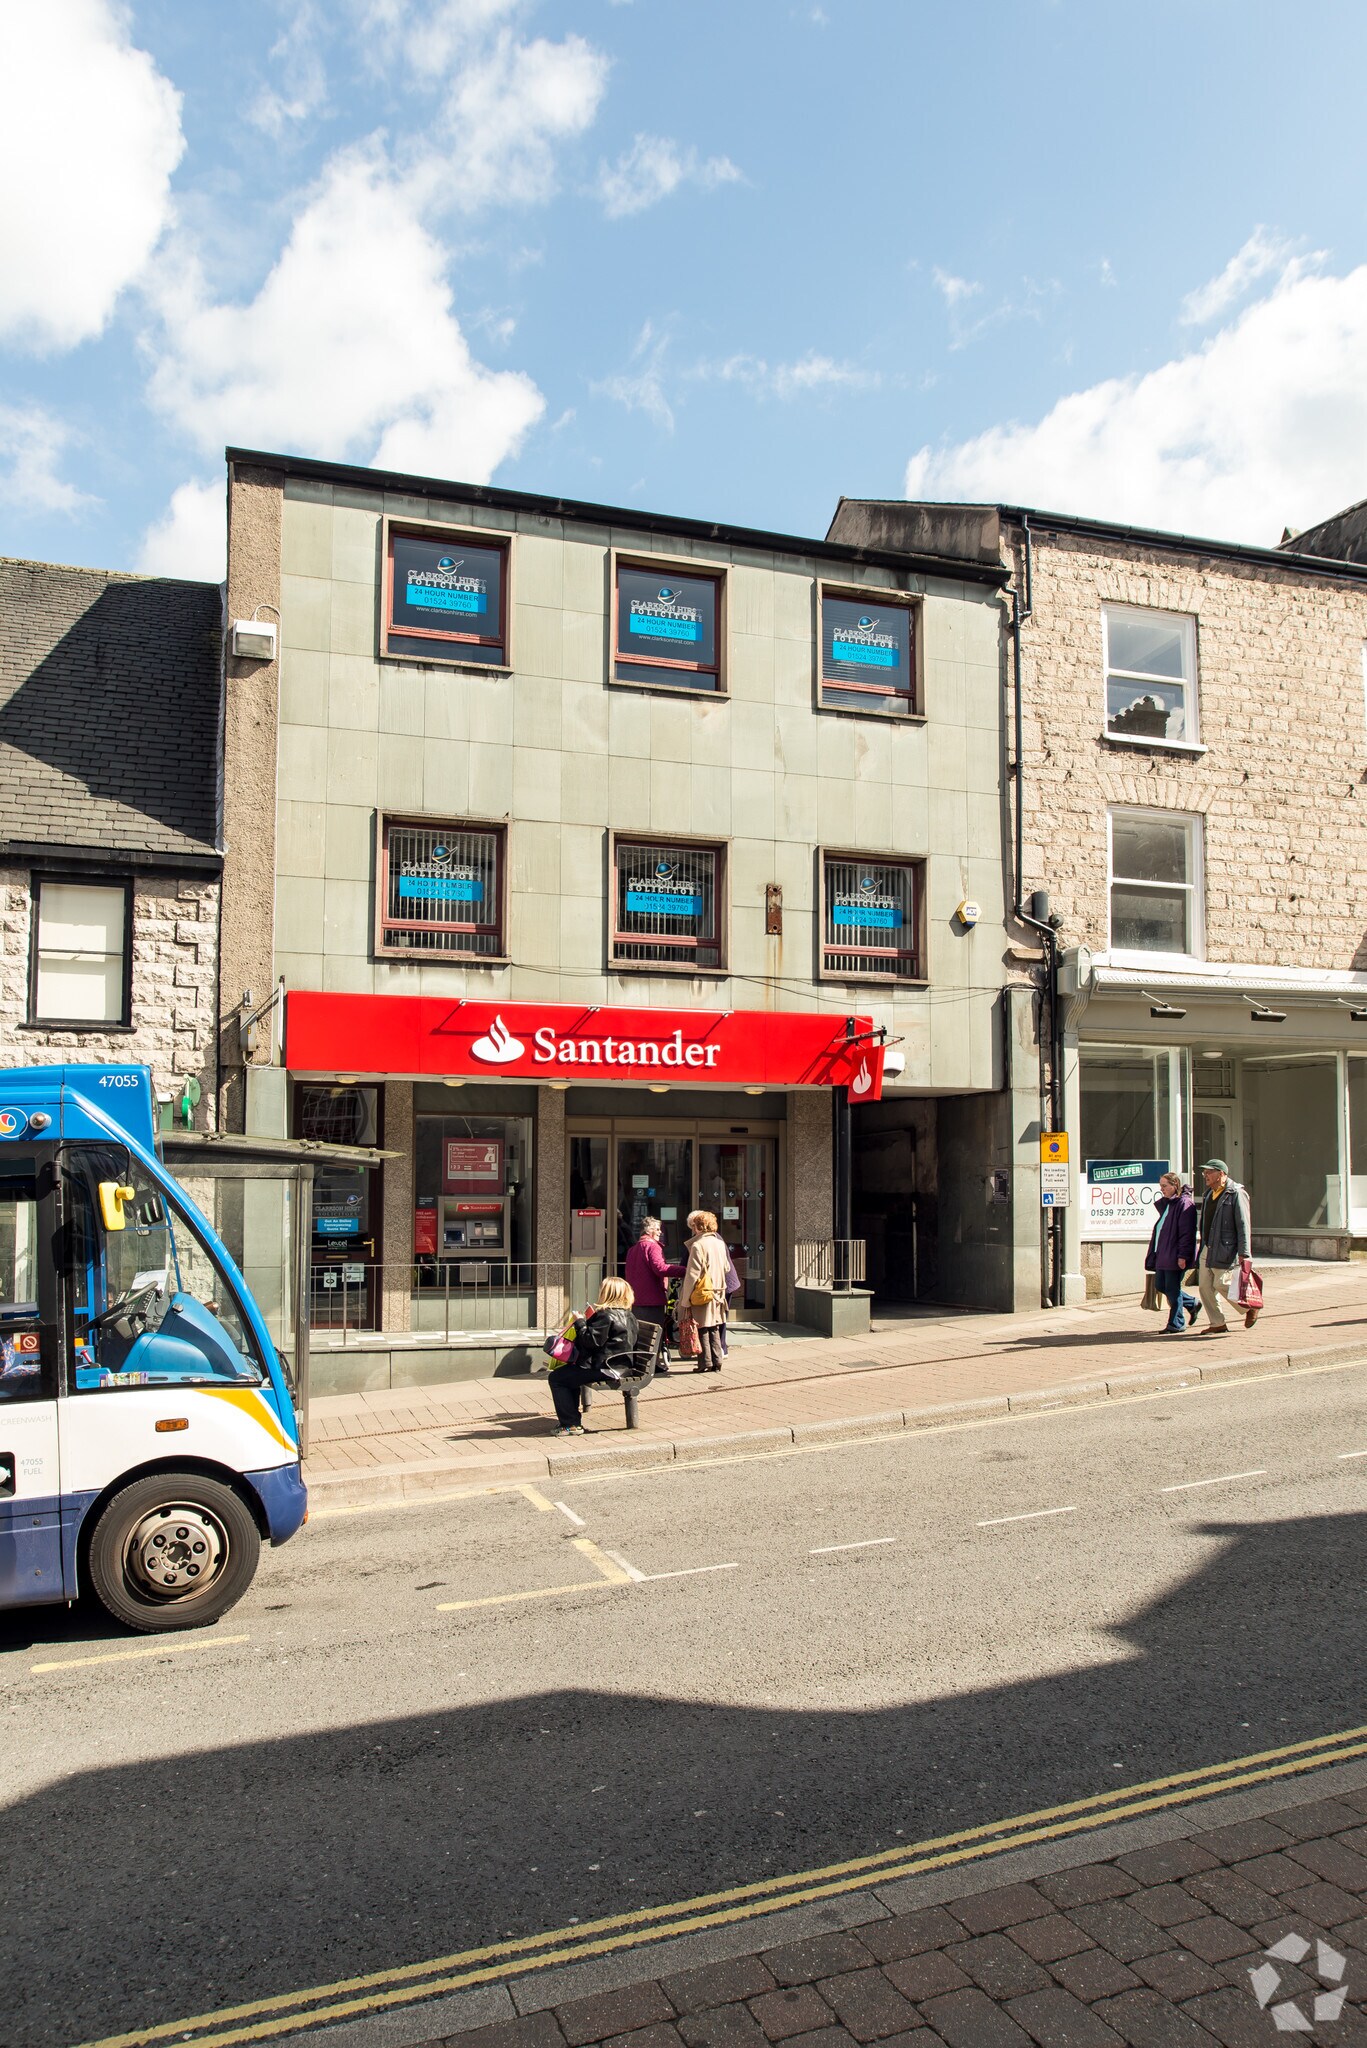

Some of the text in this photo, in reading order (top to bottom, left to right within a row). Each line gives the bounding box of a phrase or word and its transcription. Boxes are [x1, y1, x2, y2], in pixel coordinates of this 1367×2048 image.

[407, 569, 487, 588] CLARKSON HIRST
[407, 577, 487, 593] SOLICITORS
[424, 589, 446, 598] HOUR
[447, 593, 479, 602] NUMBER
[424, 597, 472, 609] 01524 39760
[630, 599, 676, 613] CLARKSON
[416, 606, 478, 618] www.clarksonhirst.com
[630, 607, 703, 622] SOLICITORS
[646, 626, 667, 634] 01524
[667, 621, 696, 630] NUMBER
[833, 628, 874, 640] CLARKSON
[833, 634, 899, 649] SOLICITORS
[847, 645, 866, 653] HOUR
[401, 868, 481, 882] SOLICITOR
[667, 904, 689, 912] 39760
[534, 1027, 721, 1067] Santander
[99, 1075, 138, 1087] 47055
[1095, 1166, 1141, 1179] UNDER OFFER
[21, 1458, 43, 1466] 47055
